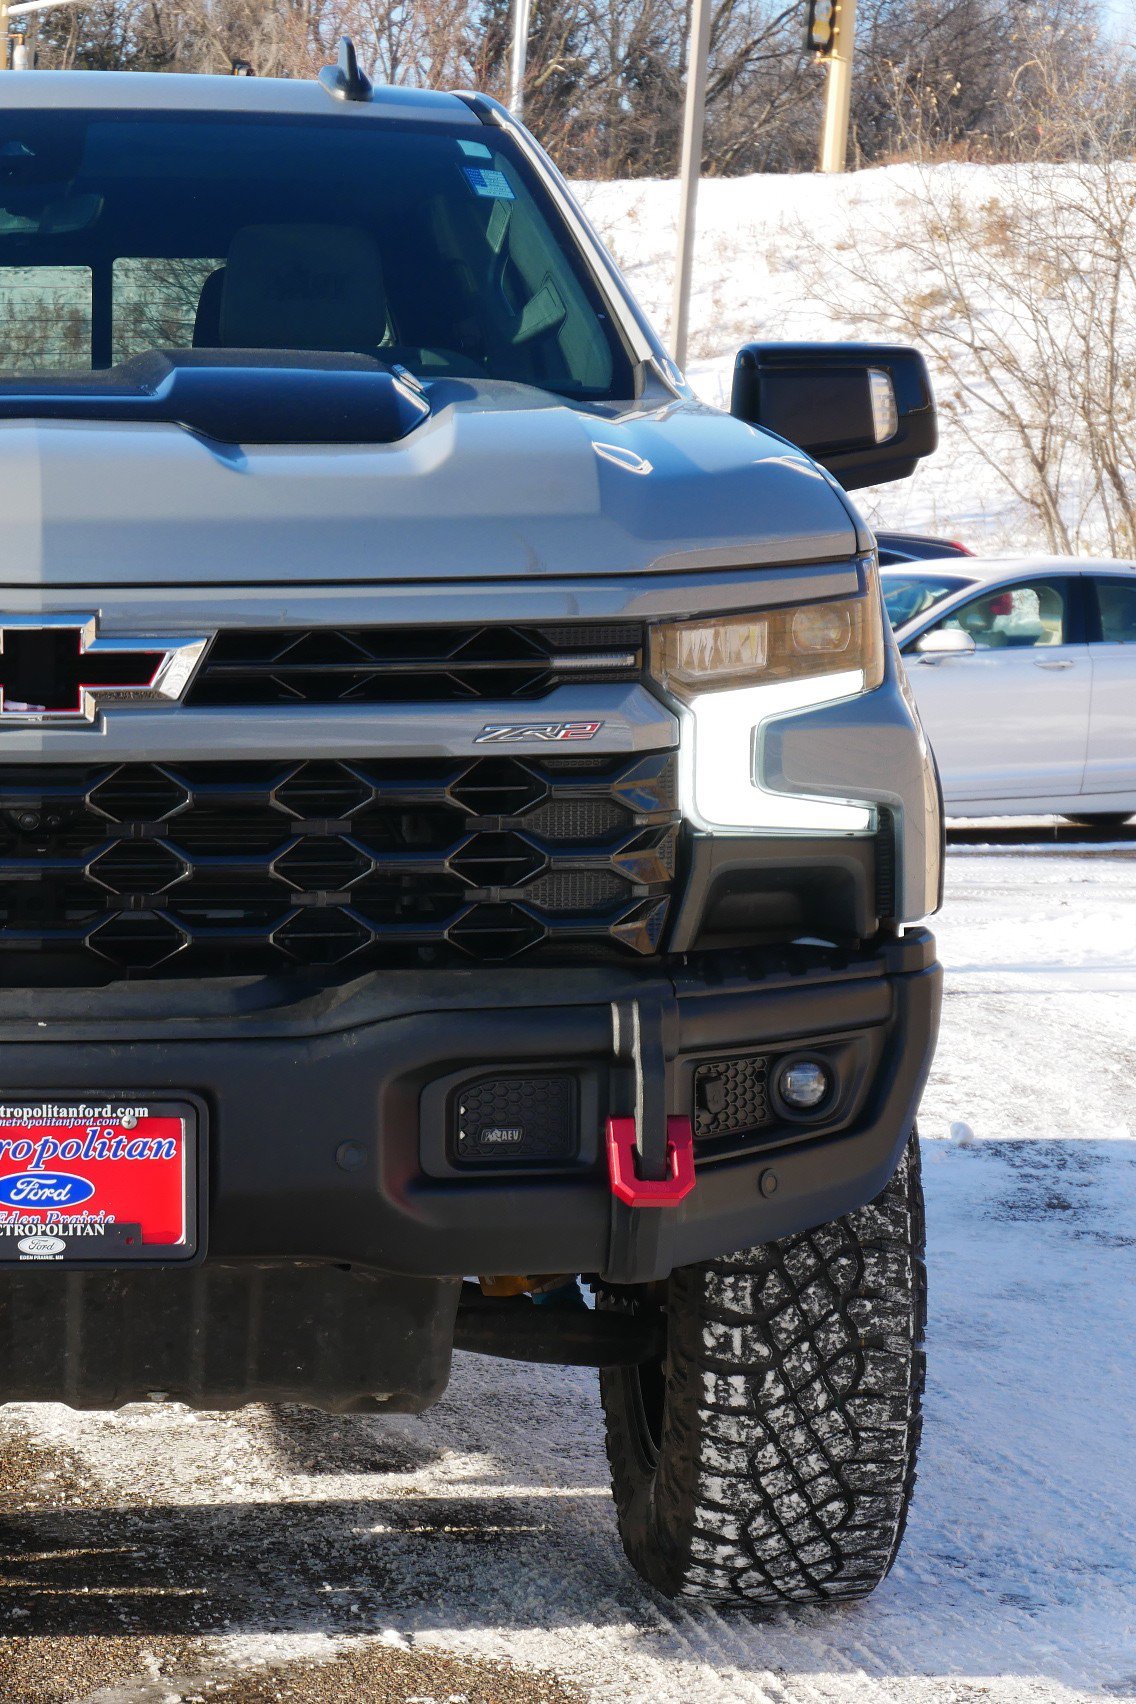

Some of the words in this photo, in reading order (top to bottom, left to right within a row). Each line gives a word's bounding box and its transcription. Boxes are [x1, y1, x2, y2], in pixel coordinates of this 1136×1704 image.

[473, 720, 605, 744] ZR2
[501, 1130, 519, 1141] AEV
[10, 1177, 71, 1202] Ford
[46, 1210, 116, 1224] Prairie
[28, 1238, 55, 1251] Ford
